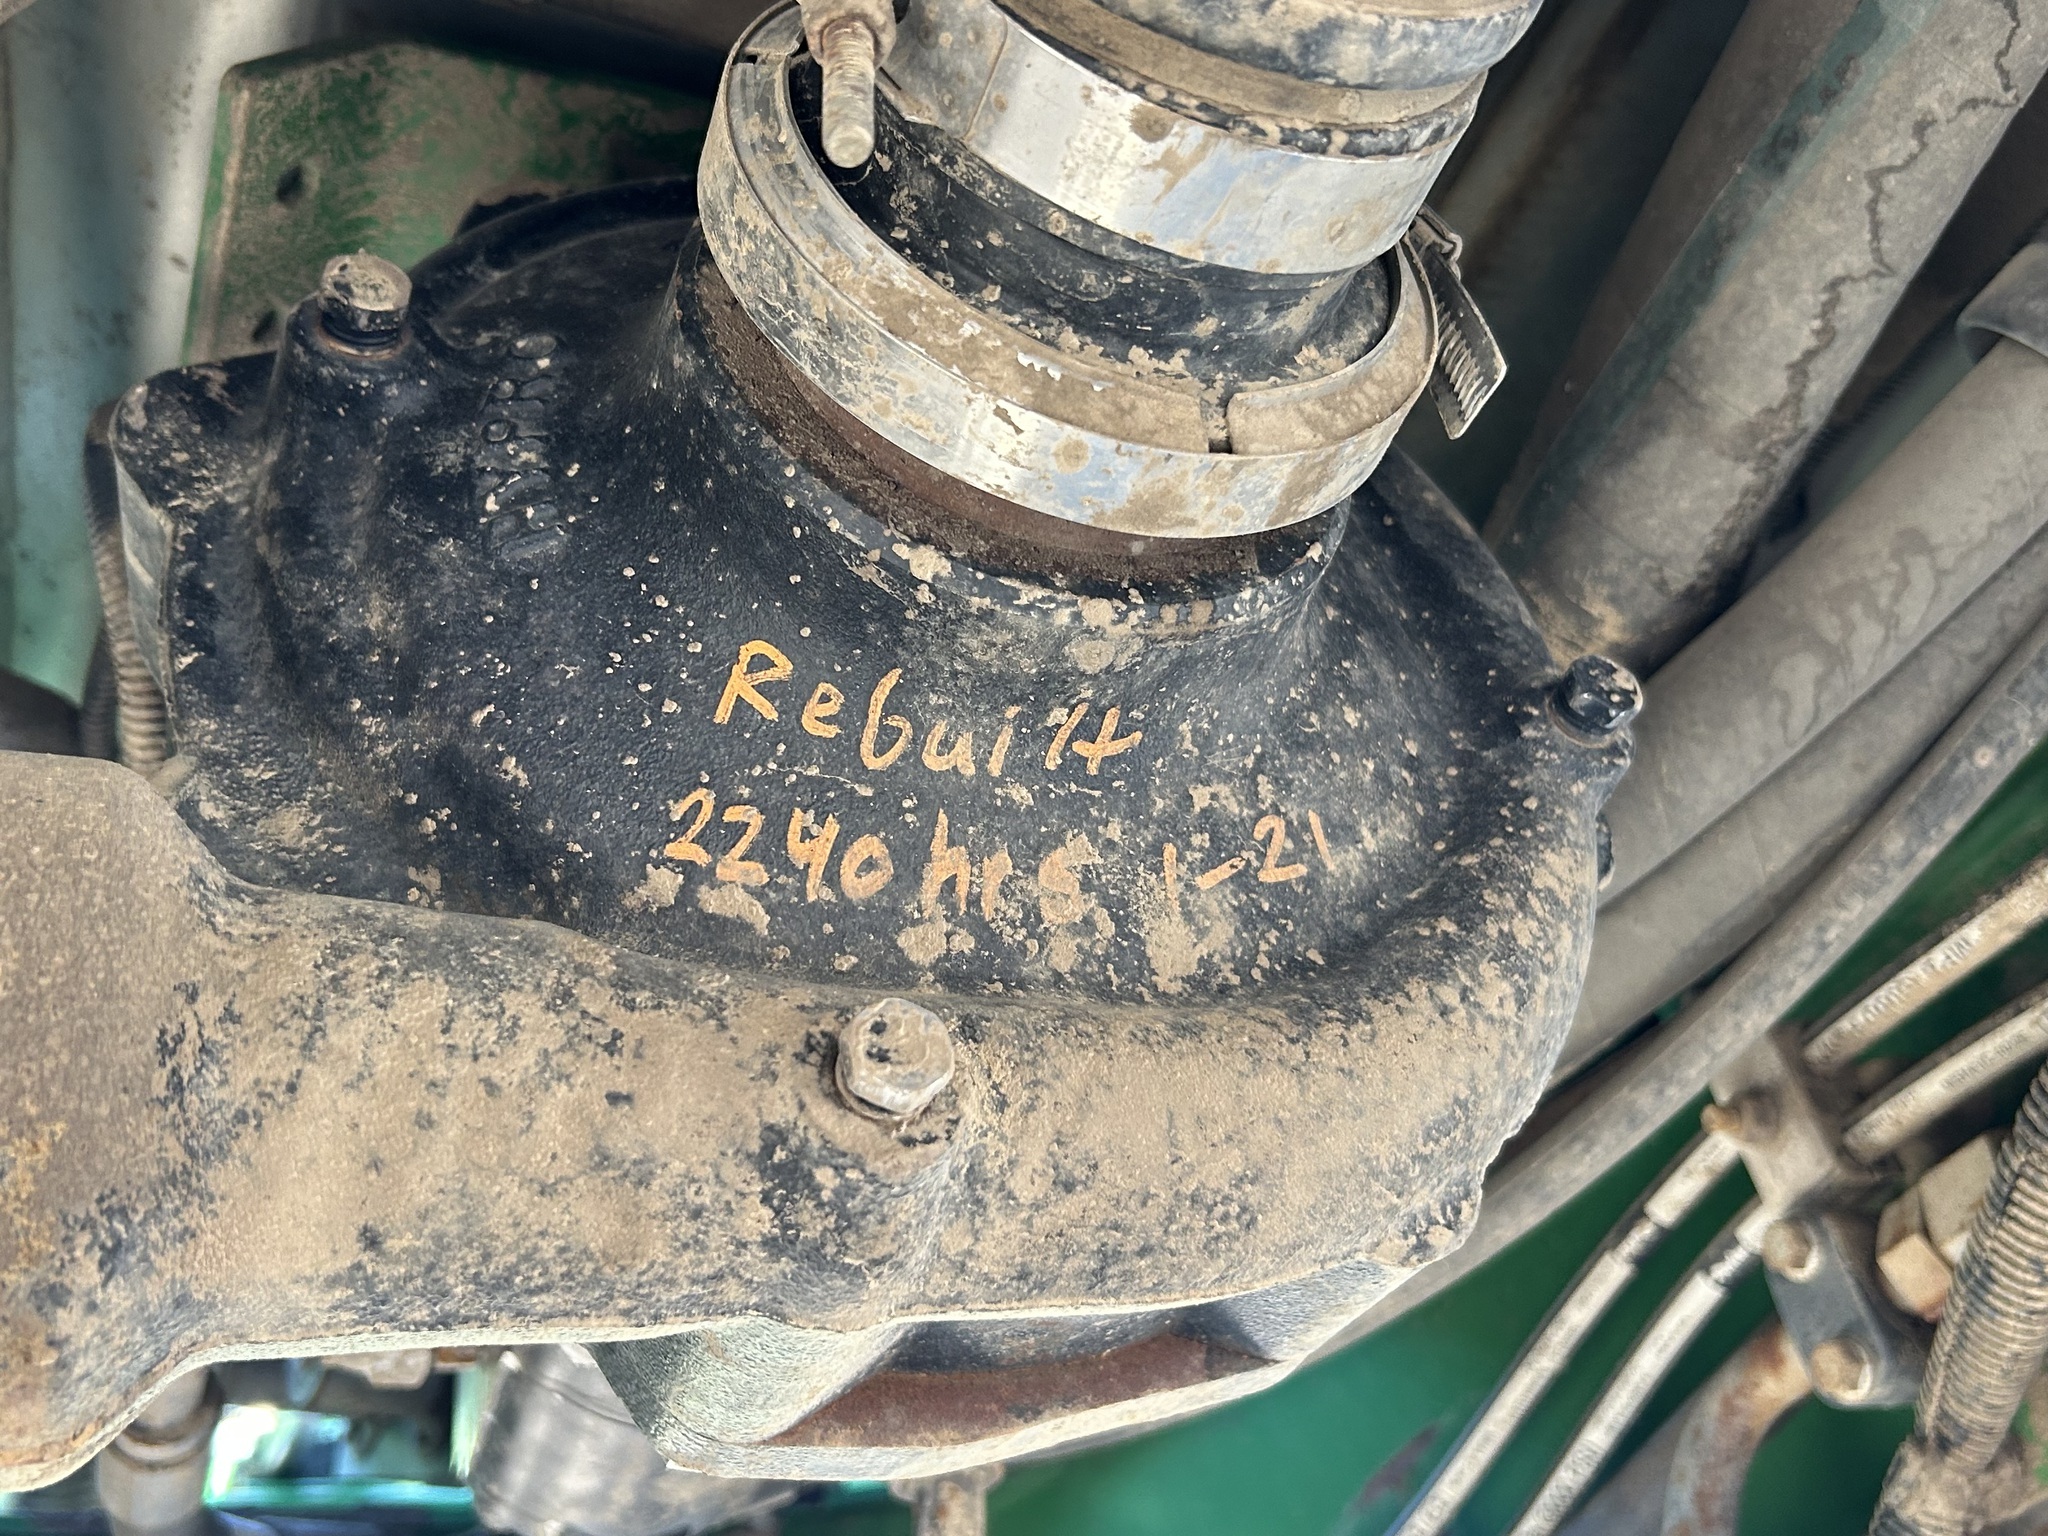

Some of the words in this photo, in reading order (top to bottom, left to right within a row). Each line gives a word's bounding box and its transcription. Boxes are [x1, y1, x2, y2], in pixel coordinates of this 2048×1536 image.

[713, 639, 1143, 777] Rebuilt
[665, 788, 894, 901] 2240
[921, 807, 1086, 924] hrs
[1162, 808, 1336, 911] 1-21
